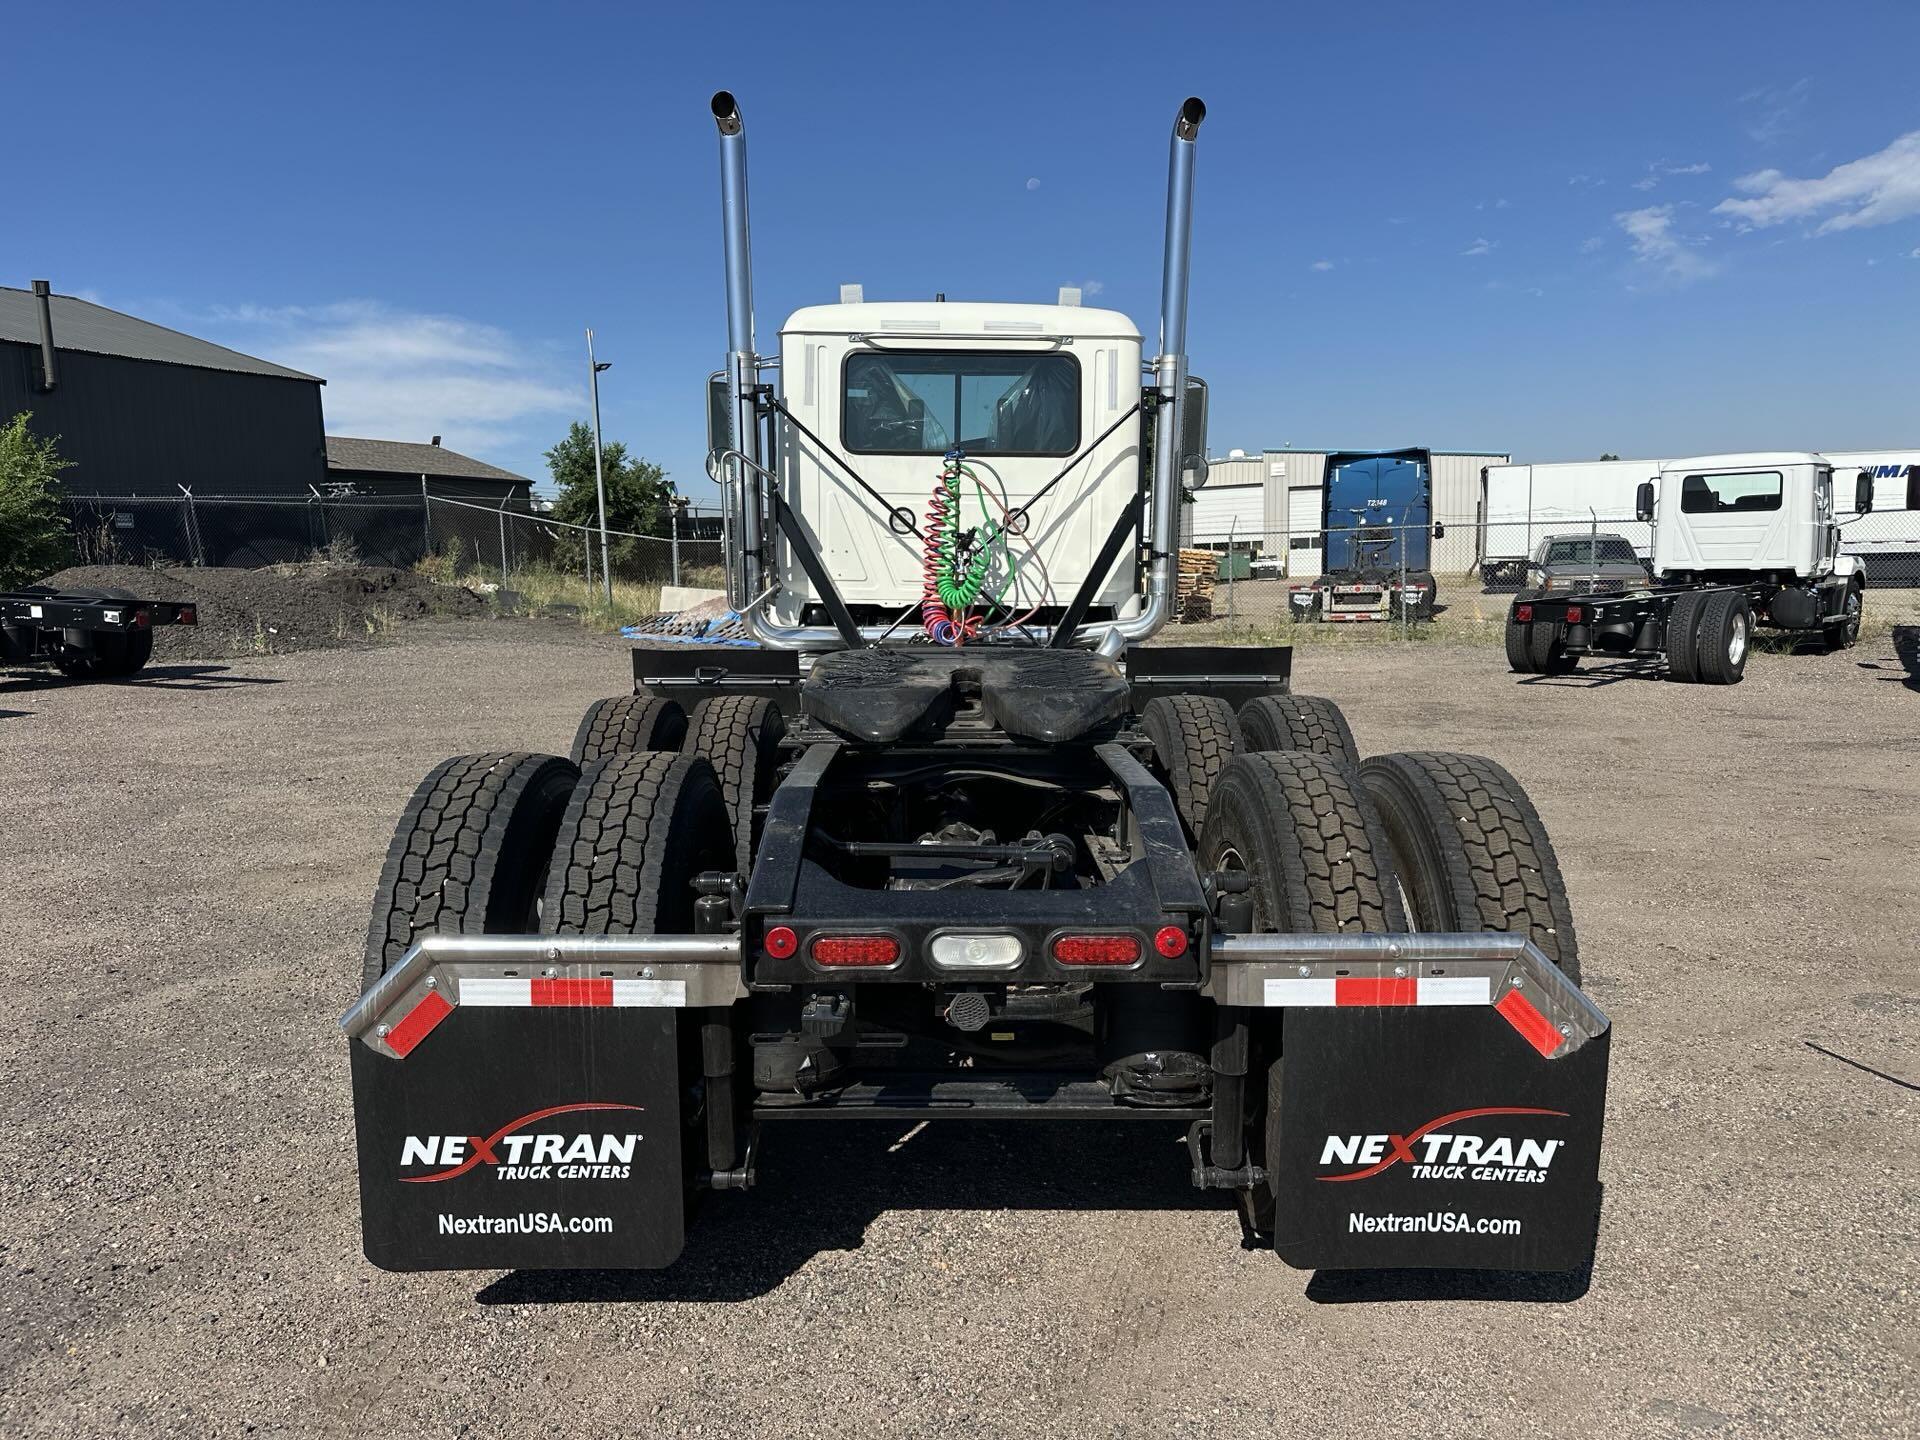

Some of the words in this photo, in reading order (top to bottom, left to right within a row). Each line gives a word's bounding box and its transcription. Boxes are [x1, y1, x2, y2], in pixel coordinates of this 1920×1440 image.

[497, 1166, 552, 1180] TRUCK
[557, 1165, 631, 1179] CENTERS
[1411, 1165, 1467, 1180] TRUCK
[1471, 1166, 1548, 1183] CENTERS
[438, 1213, 613, 1234] NextranUSA.com
[1349, 1212, 1521, 1235] NextranUSA.com
